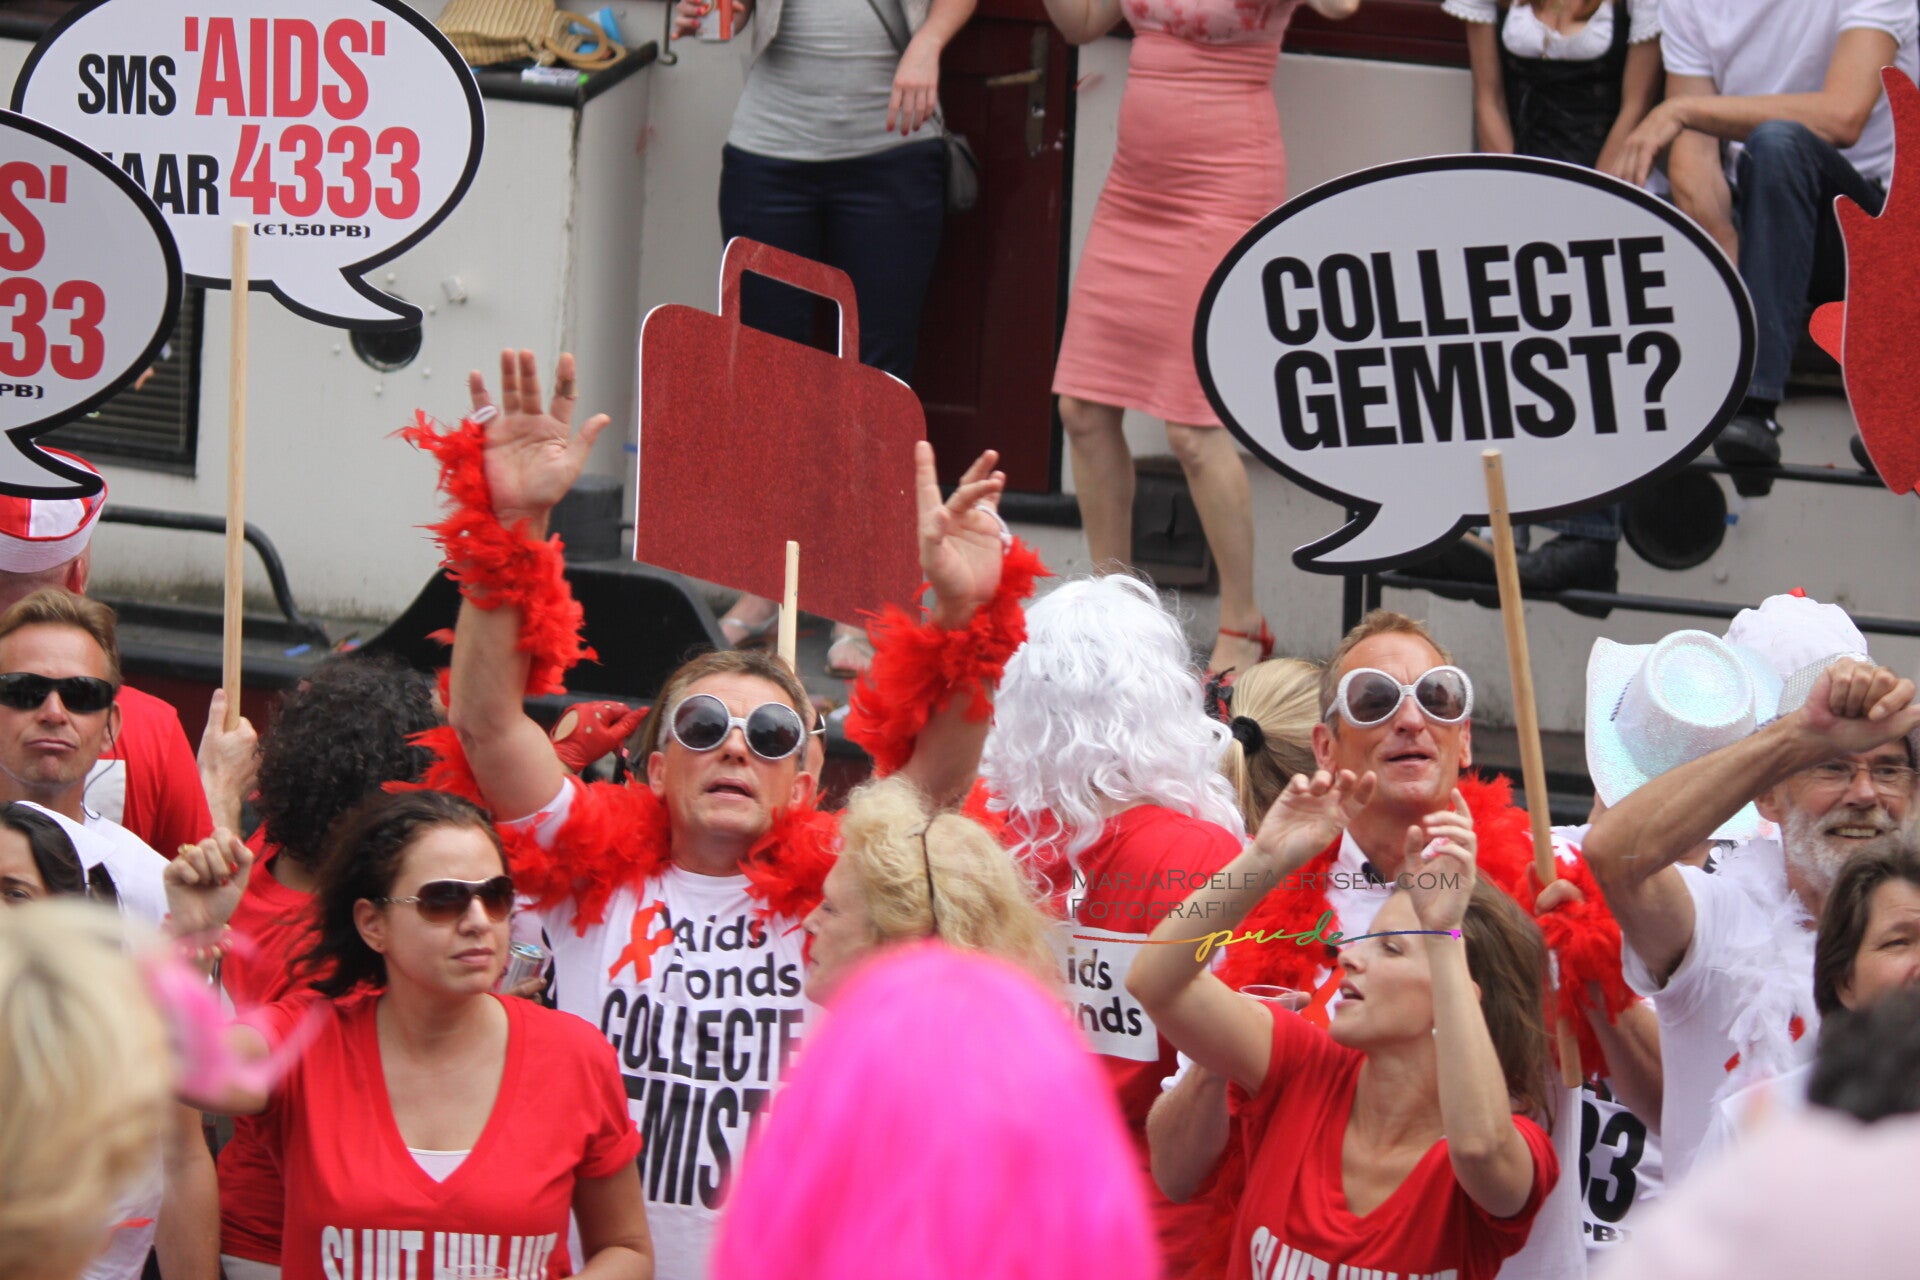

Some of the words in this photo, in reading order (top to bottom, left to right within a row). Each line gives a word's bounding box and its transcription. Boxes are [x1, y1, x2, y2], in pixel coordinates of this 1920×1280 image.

[78, 53, 177, 116] SMS
[184, 17, 387, 121] 'AIDS'
[102, 152, 220, 216] AAR
[230, 124, 421, 220] 4333
[254, 222, 325, 238] (€1,50
[330, 224, 371, 239] PB)
[1261, 236, 1675, 346] COLLECTE
[1274, 330, 1682, 451] GEMIST?
[1066, 946, 1113, 990] ids
